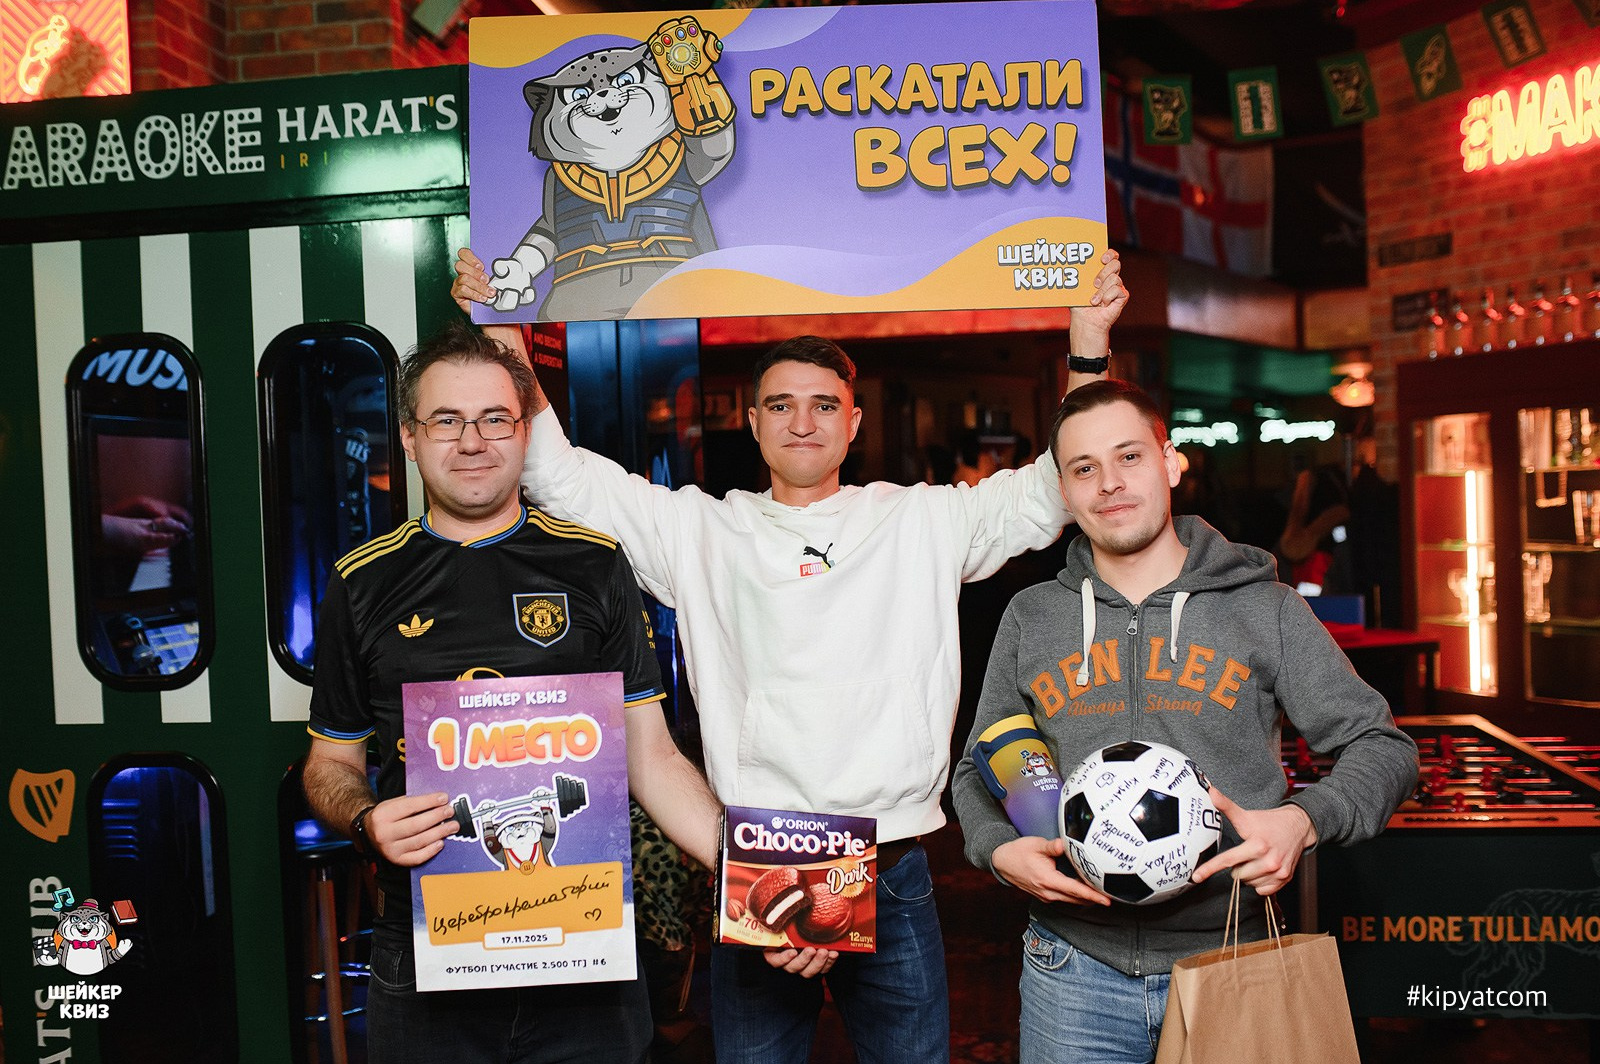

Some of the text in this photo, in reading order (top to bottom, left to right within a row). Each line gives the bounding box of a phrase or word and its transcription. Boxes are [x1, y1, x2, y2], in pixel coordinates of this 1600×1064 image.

[750, 59, 1083, 118] РАСКАТАЛИ
[277, 94, 458, 143] HARAT'S
[0, 107, 265, 190] ARAOKE
[854, 122, 1078, 191] ВСЕХ!
[998, 238, 1094, 266] ШЕЙКЕР
[1014, 267, 1079, 290] КВИЗ
[532, 626, 557, 635] UNITED
[1029, 636, 1251, 719] BEN LEE
[459, 689, 567, 709] ШЕЙКЕР КВИЗ
[1068, 694, 1203, 717] Always Strong
[431, 720, 456, 768] 1
[467, 718, 599, 766] МЕСТО
[1032, 777, 1059, 787] ШЕЙКЕР
[1040, 783, 1059, 792] КВИЗ
[785, 818, 826, 832] ORION
[826, 863, 874, 895] Dark
[501, 933, 548, 945] 17.11.2025
[1342, 915, 1377, 942] BE
[1383, 915, 1463, 942] MORE
[445, 965, 487, 974] ФУТБОЛ
[490, 961, 539, 973] [УЧАСТИЕ
[542, 959, 568, 969] 2.500
